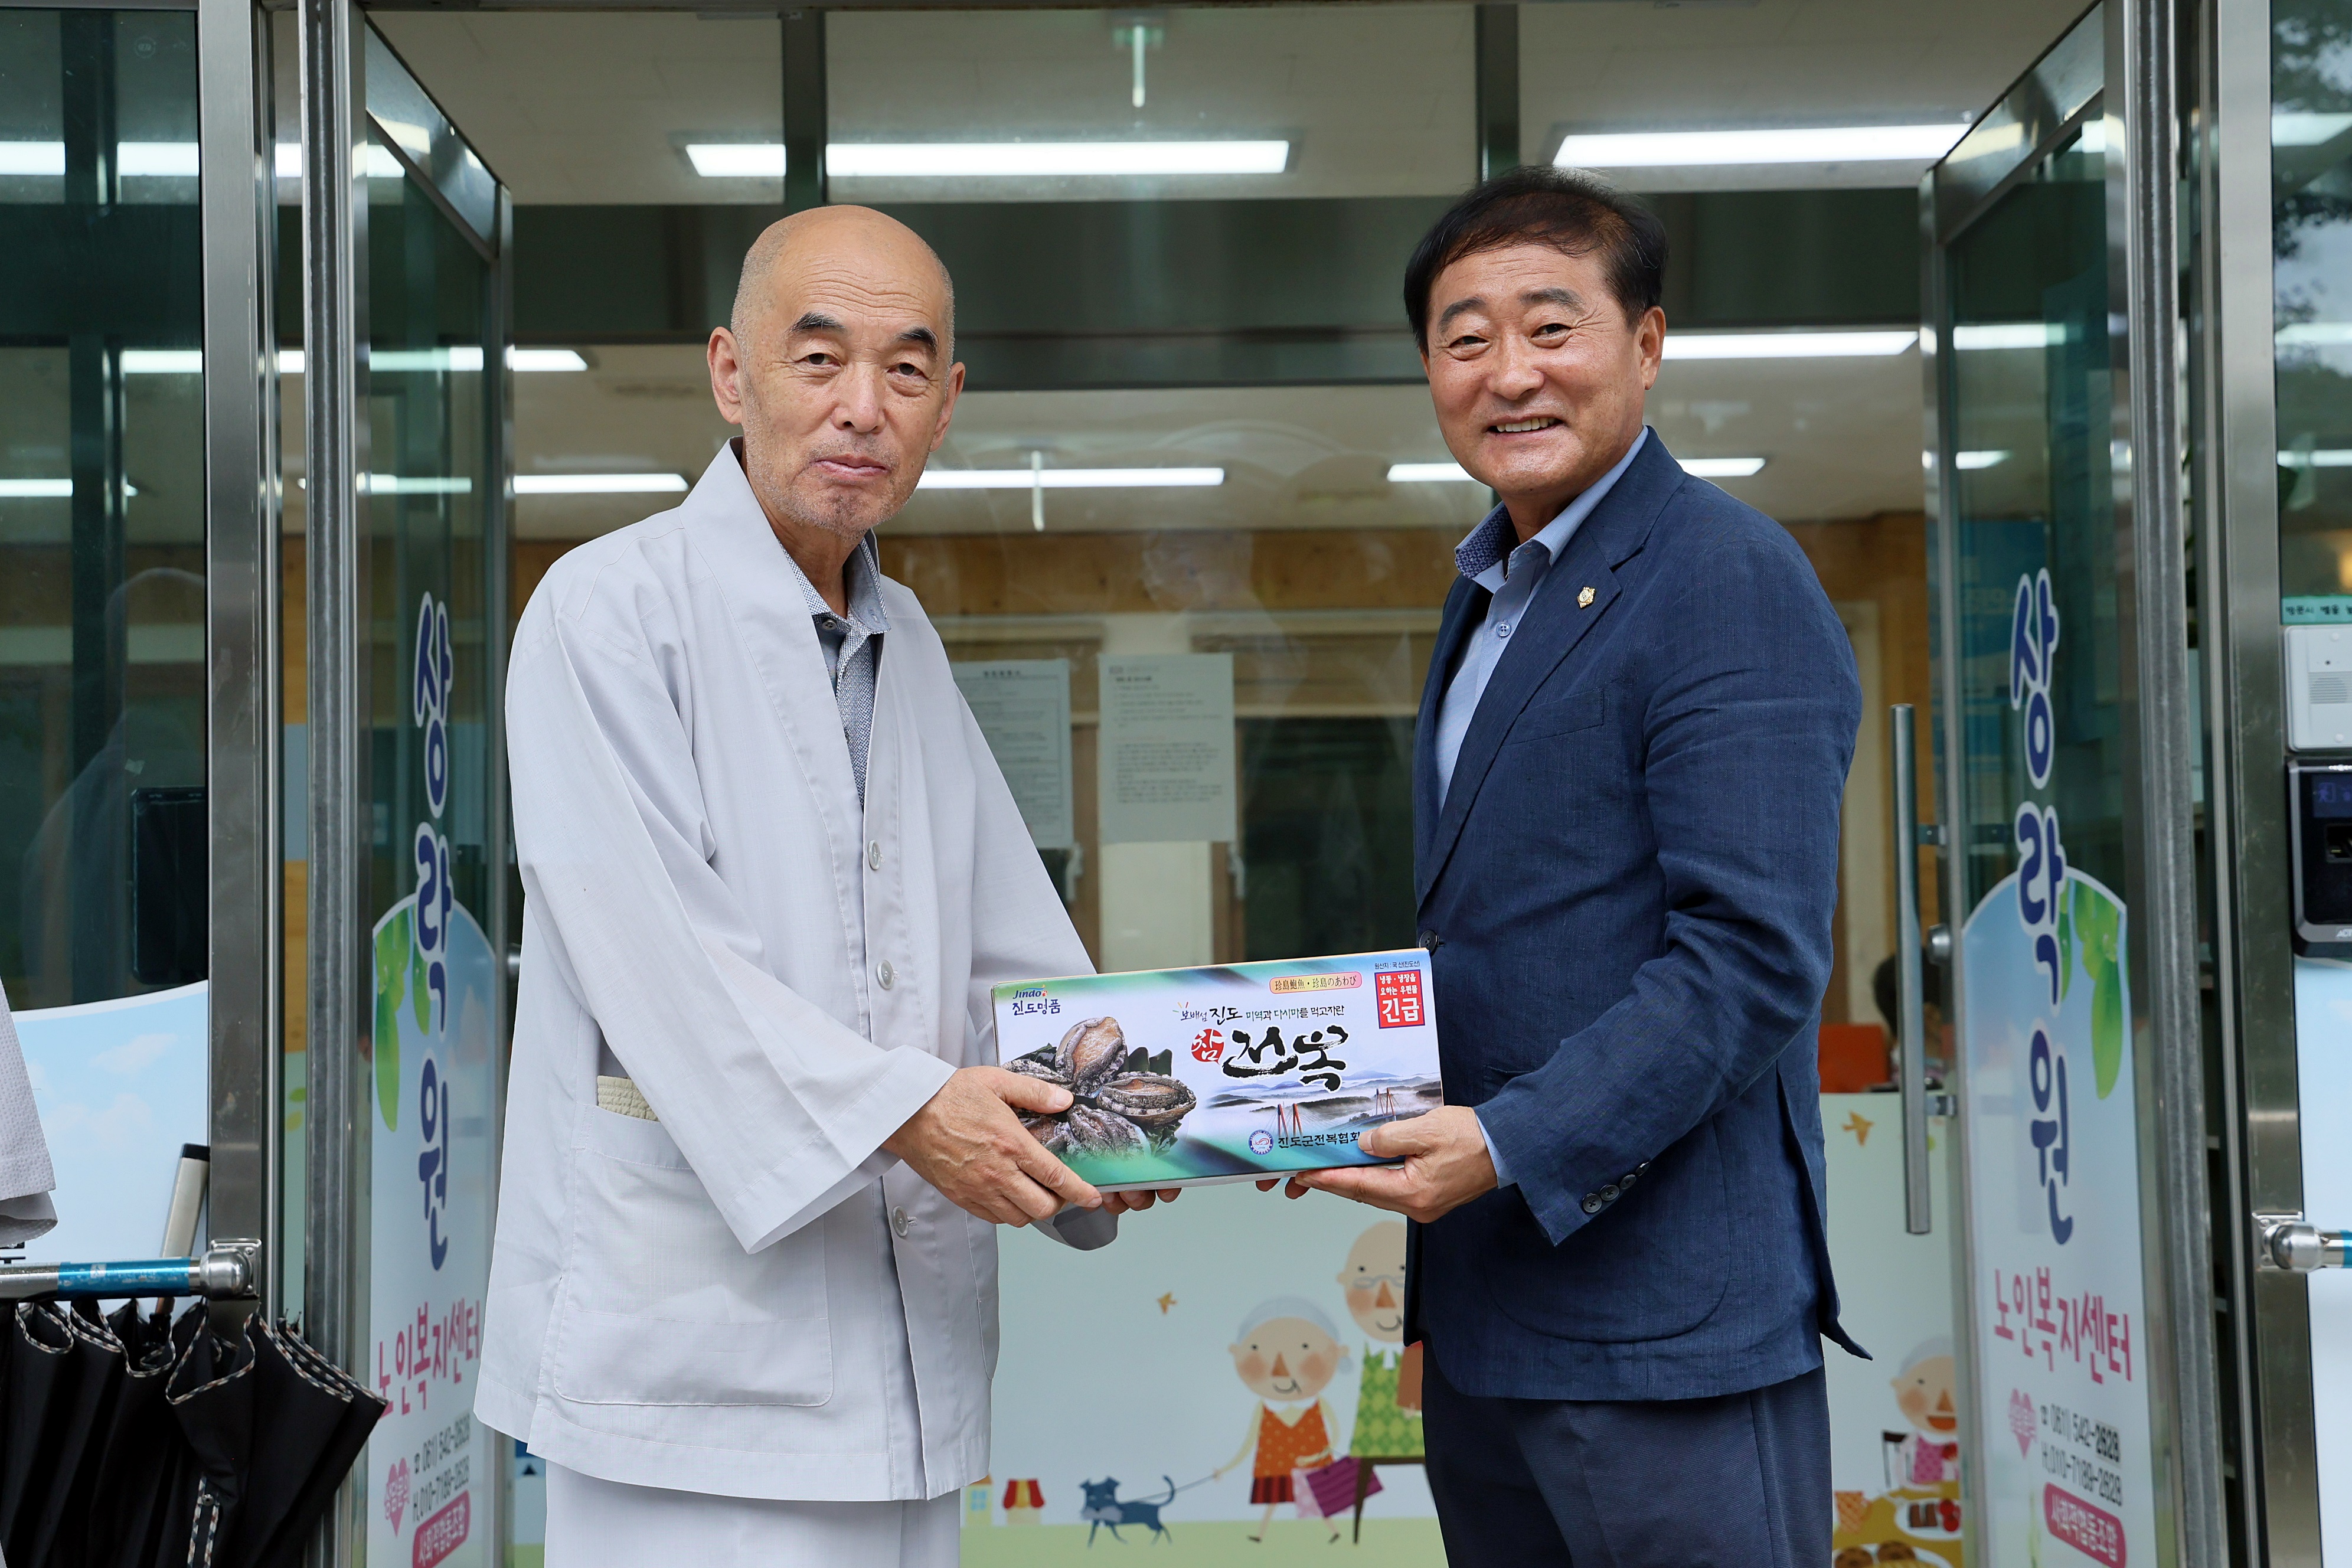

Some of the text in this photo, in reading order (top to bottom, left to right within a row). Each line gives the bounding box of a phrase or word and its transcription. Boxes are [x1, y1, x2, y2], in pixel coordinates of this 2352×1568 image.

[2013, 576, 2073, 1244] 상락원
[416, 590, 452, 1272] 상락원
[1379, 975, 1391, 984] 냉동
[1397, 973, 1416, 983] 냉장을
[1012, 990, 1041, 999] Jindo
[1380, 985, 1418, 996] 요하는 우편물
[1012, 998, 1060, 1015] 진도명품
[1181, 1005, 1345, 1025] 보배섬 진도 미역과 다시마를 먹고자란
[1382, 997, 1420, 1023] 긴급
[1193, 1025, 1349, 1092] 참 전복
[1278, 1132, 1360, 1148] 진도군전복협회
[1994, 1266, 2132, 1384] 노인복지센터
[378, 1299, 480, 1420] 노인복지센터
